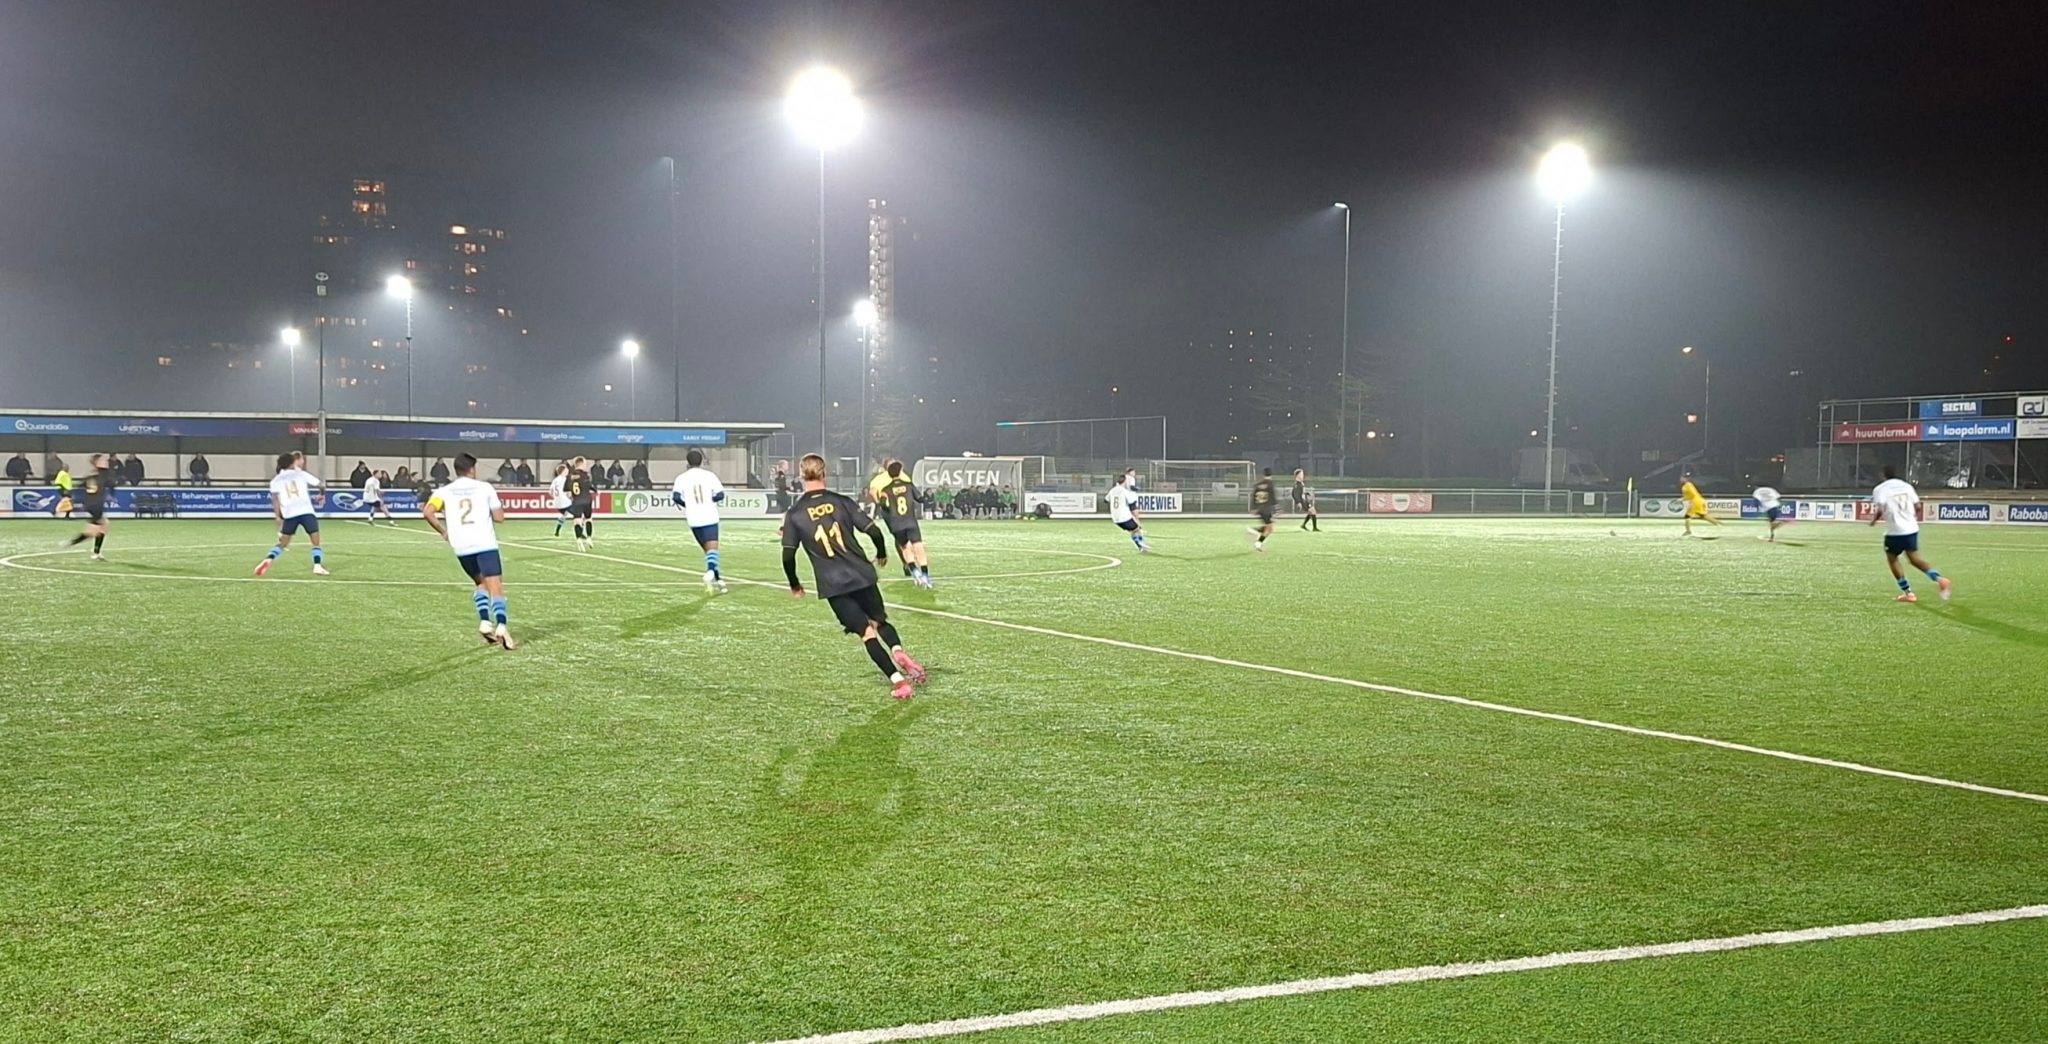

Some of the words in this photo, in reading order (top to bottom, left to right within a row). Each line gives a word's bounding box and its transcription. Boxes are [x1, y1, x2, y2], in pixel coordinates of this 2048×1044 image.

[1855, 426, 1917, 438] huuralarm.nl
[1943, 422, 2011, 438] koopalarm.nl
[925, 469, 1000, 486] GASTEN
[284, 480, 300, 497] 14
[572, 482, 581, 495] 6
[692, 484, 704, 504] 11
[897, 496, 908, 516] 8
[1113, 496, 1120, 509] 6
[1138, 495, 1178, 511] RREWIEL
[1707, 502, 1738, 510] OMEGA
[459, 498, 475, 525] 2
[1940, 504, 1988, 520] Rabobank
[814, 521, 845, 558] 11
